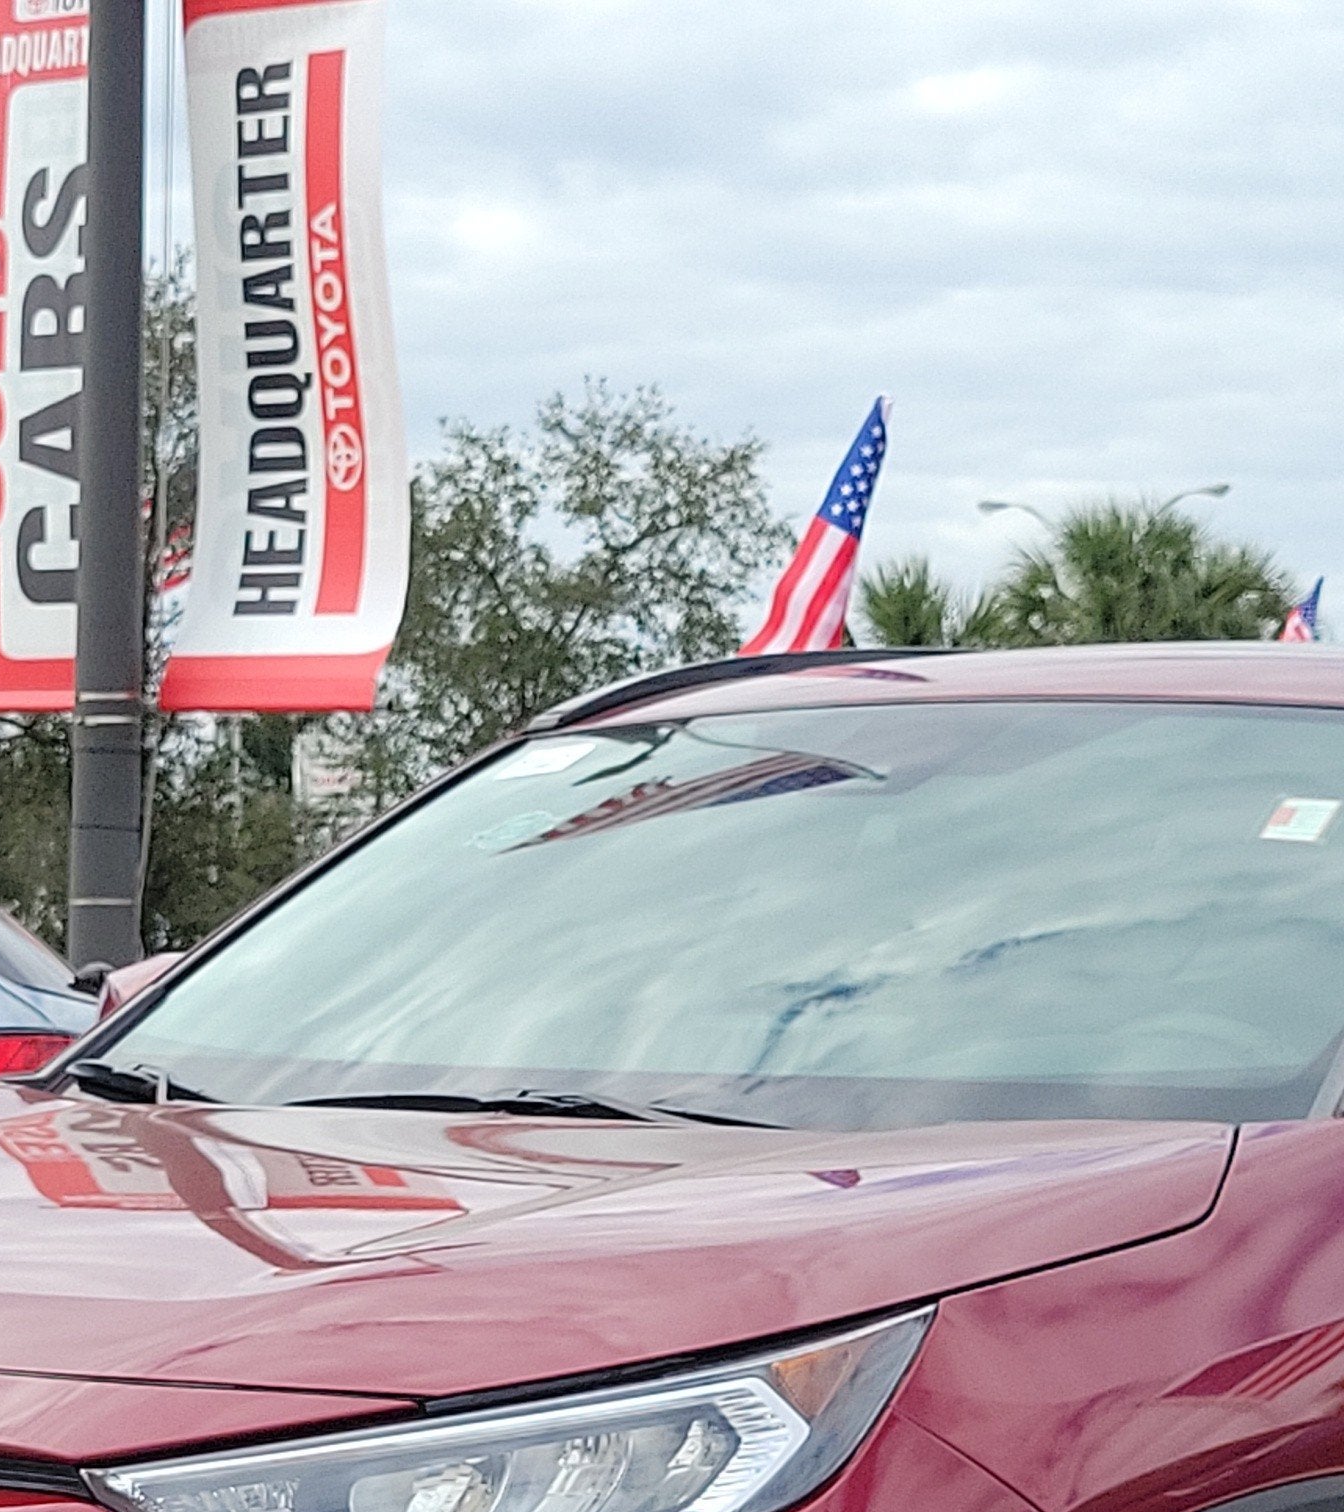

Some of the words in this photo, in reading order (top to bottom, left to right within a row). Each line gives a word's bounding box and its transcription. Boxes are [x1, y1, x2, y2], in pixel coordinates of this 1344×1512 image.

[16, 162, 88, 604] CARS
[233, 60, 312, 615] HEADQUARTER
[309, 202, 355, 421] TOYOTA
